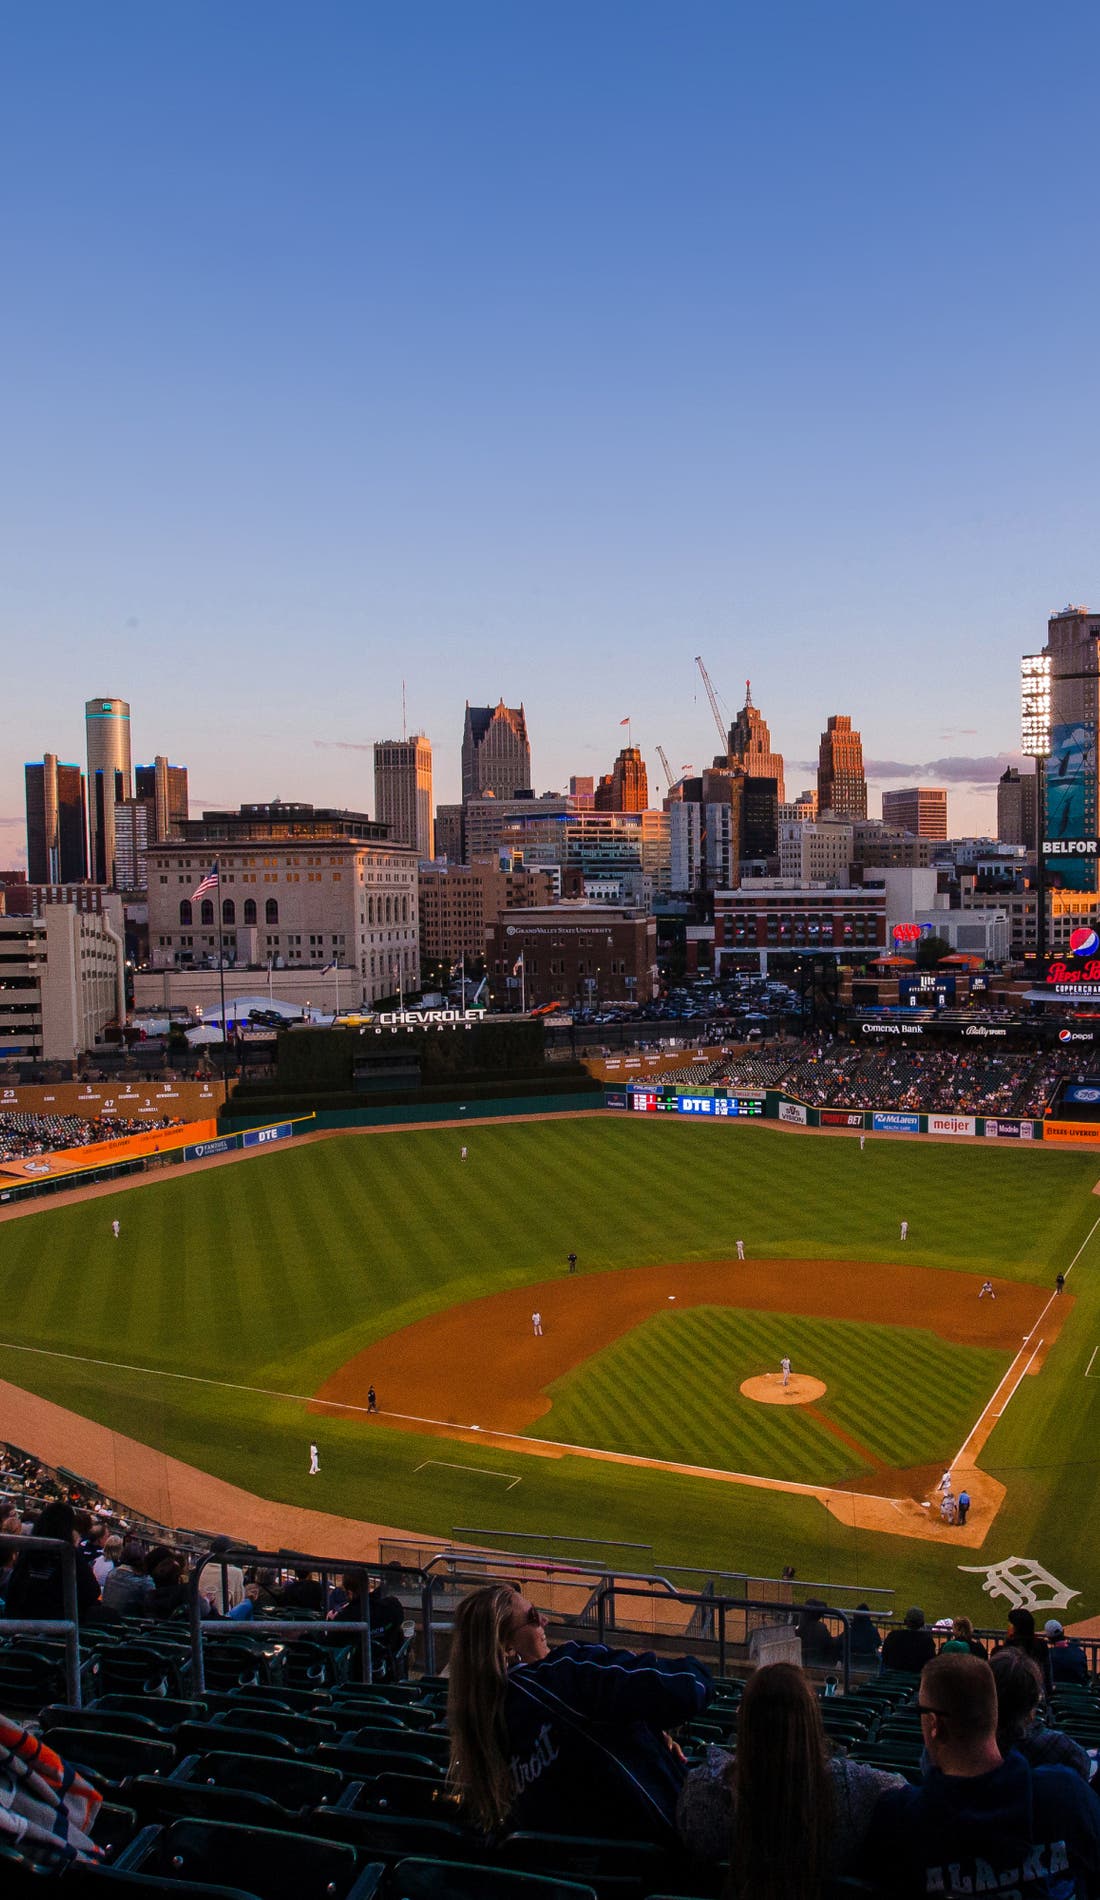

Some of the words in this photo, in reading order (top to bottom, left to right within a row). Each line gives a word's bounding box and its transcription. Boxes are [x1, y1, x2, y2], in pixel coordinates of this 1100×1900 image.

[1042, 841, 1097, 853] BELFOR
[380, 1009, 487, 1025] CHEVROLET
[360, 1023, 472, 1035] FOUNTAIN
[901, 1024, 923, 1033] Bank
[966, 1025, 989, 1037] Bally
[1072, 1033, 1094, 1041] pepsi
[3, 1089, 15, 1098] 23
[104, 1099, 114, 1107] 47
[145, 1099, 151, 1107] 3
[682, 1099, 711, 1111] DTE
[886, 1115, 917, 1125] McLaren
[934, 1118, 970, 1133] meijer
[258, 1128, 278, 1142] DTE
[957, 1556, 1082, 1613] D
